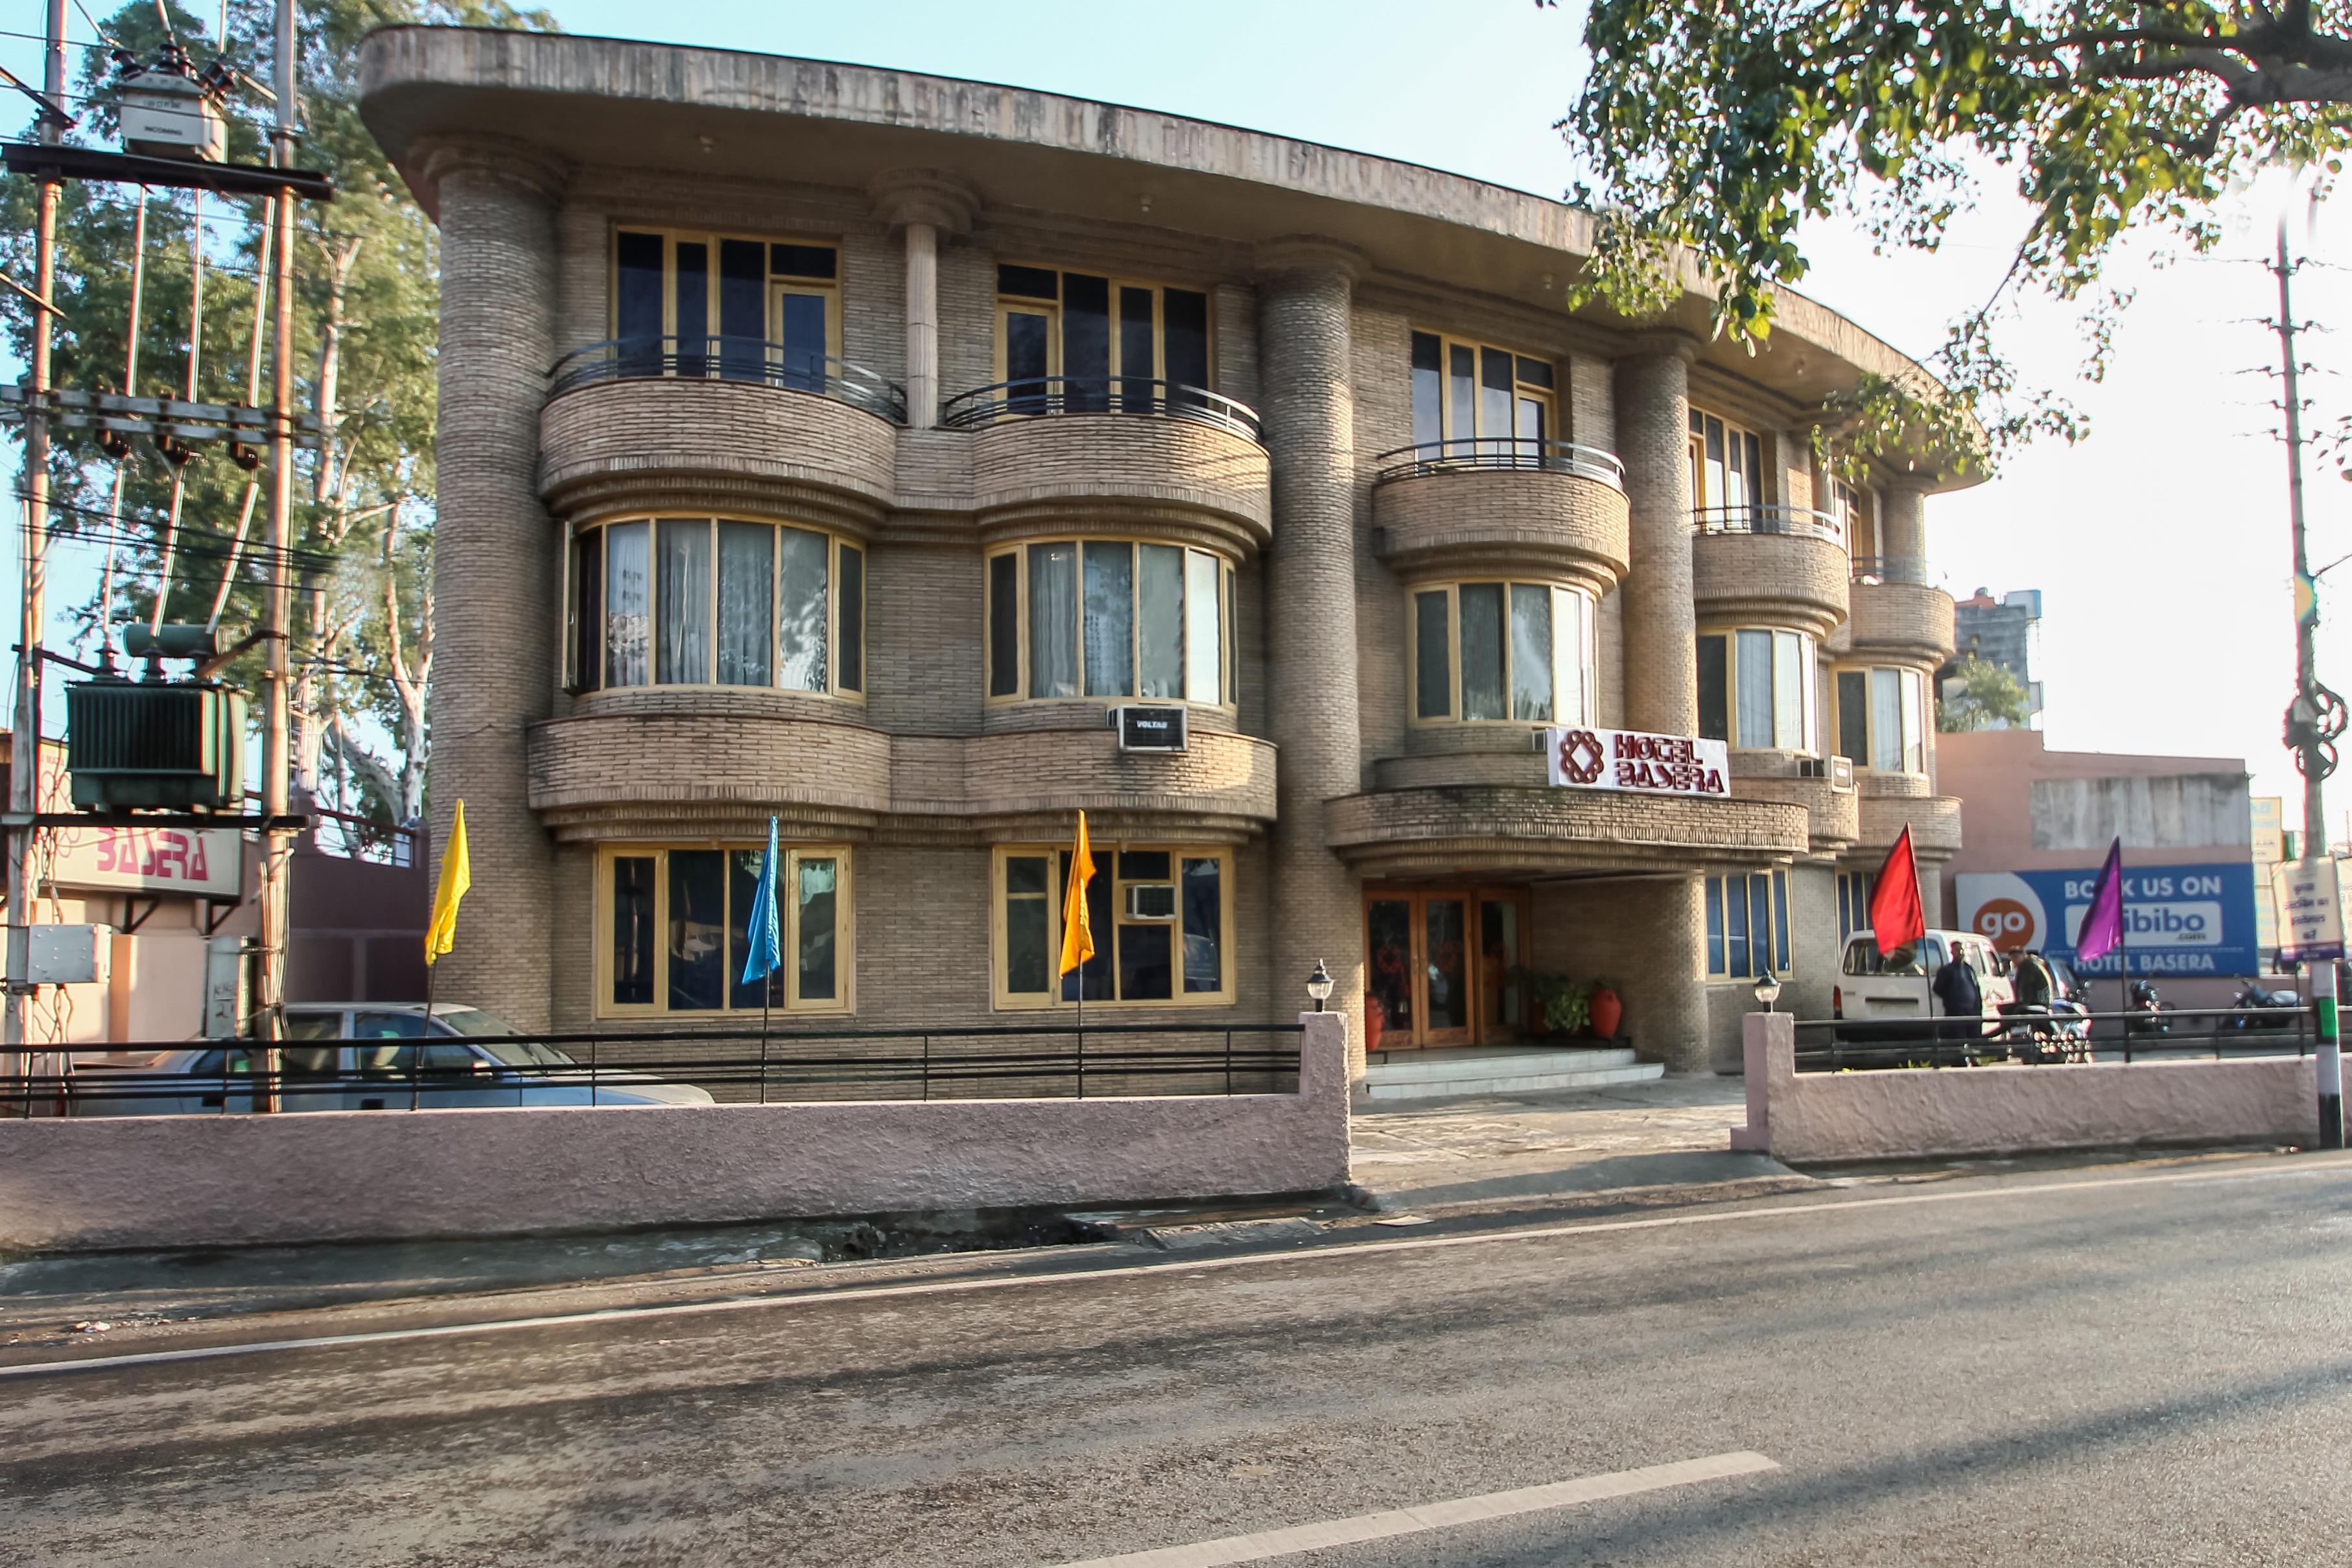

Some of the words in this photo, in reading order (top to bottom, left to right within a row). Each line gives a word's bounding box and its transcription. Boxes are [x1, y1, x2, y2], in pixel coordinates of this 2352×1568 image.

[1136, 720, 1168, 729] VOLTAS
[1613, 734, 1703, 764] HOTEL
[1614, 760, 1724, 793] BASERA
[2064, 878, 2135, 899] BOK
[2142, 877, 2174, 897] US
[2180, 876, 2221, 895] ON
[1981, 911, 2026, 939] go
[2176, 932, 2206, 941] .com
[2074, 955, 2134, 971] HOTEL
[2140, 954, 2215, 970] BASERA
